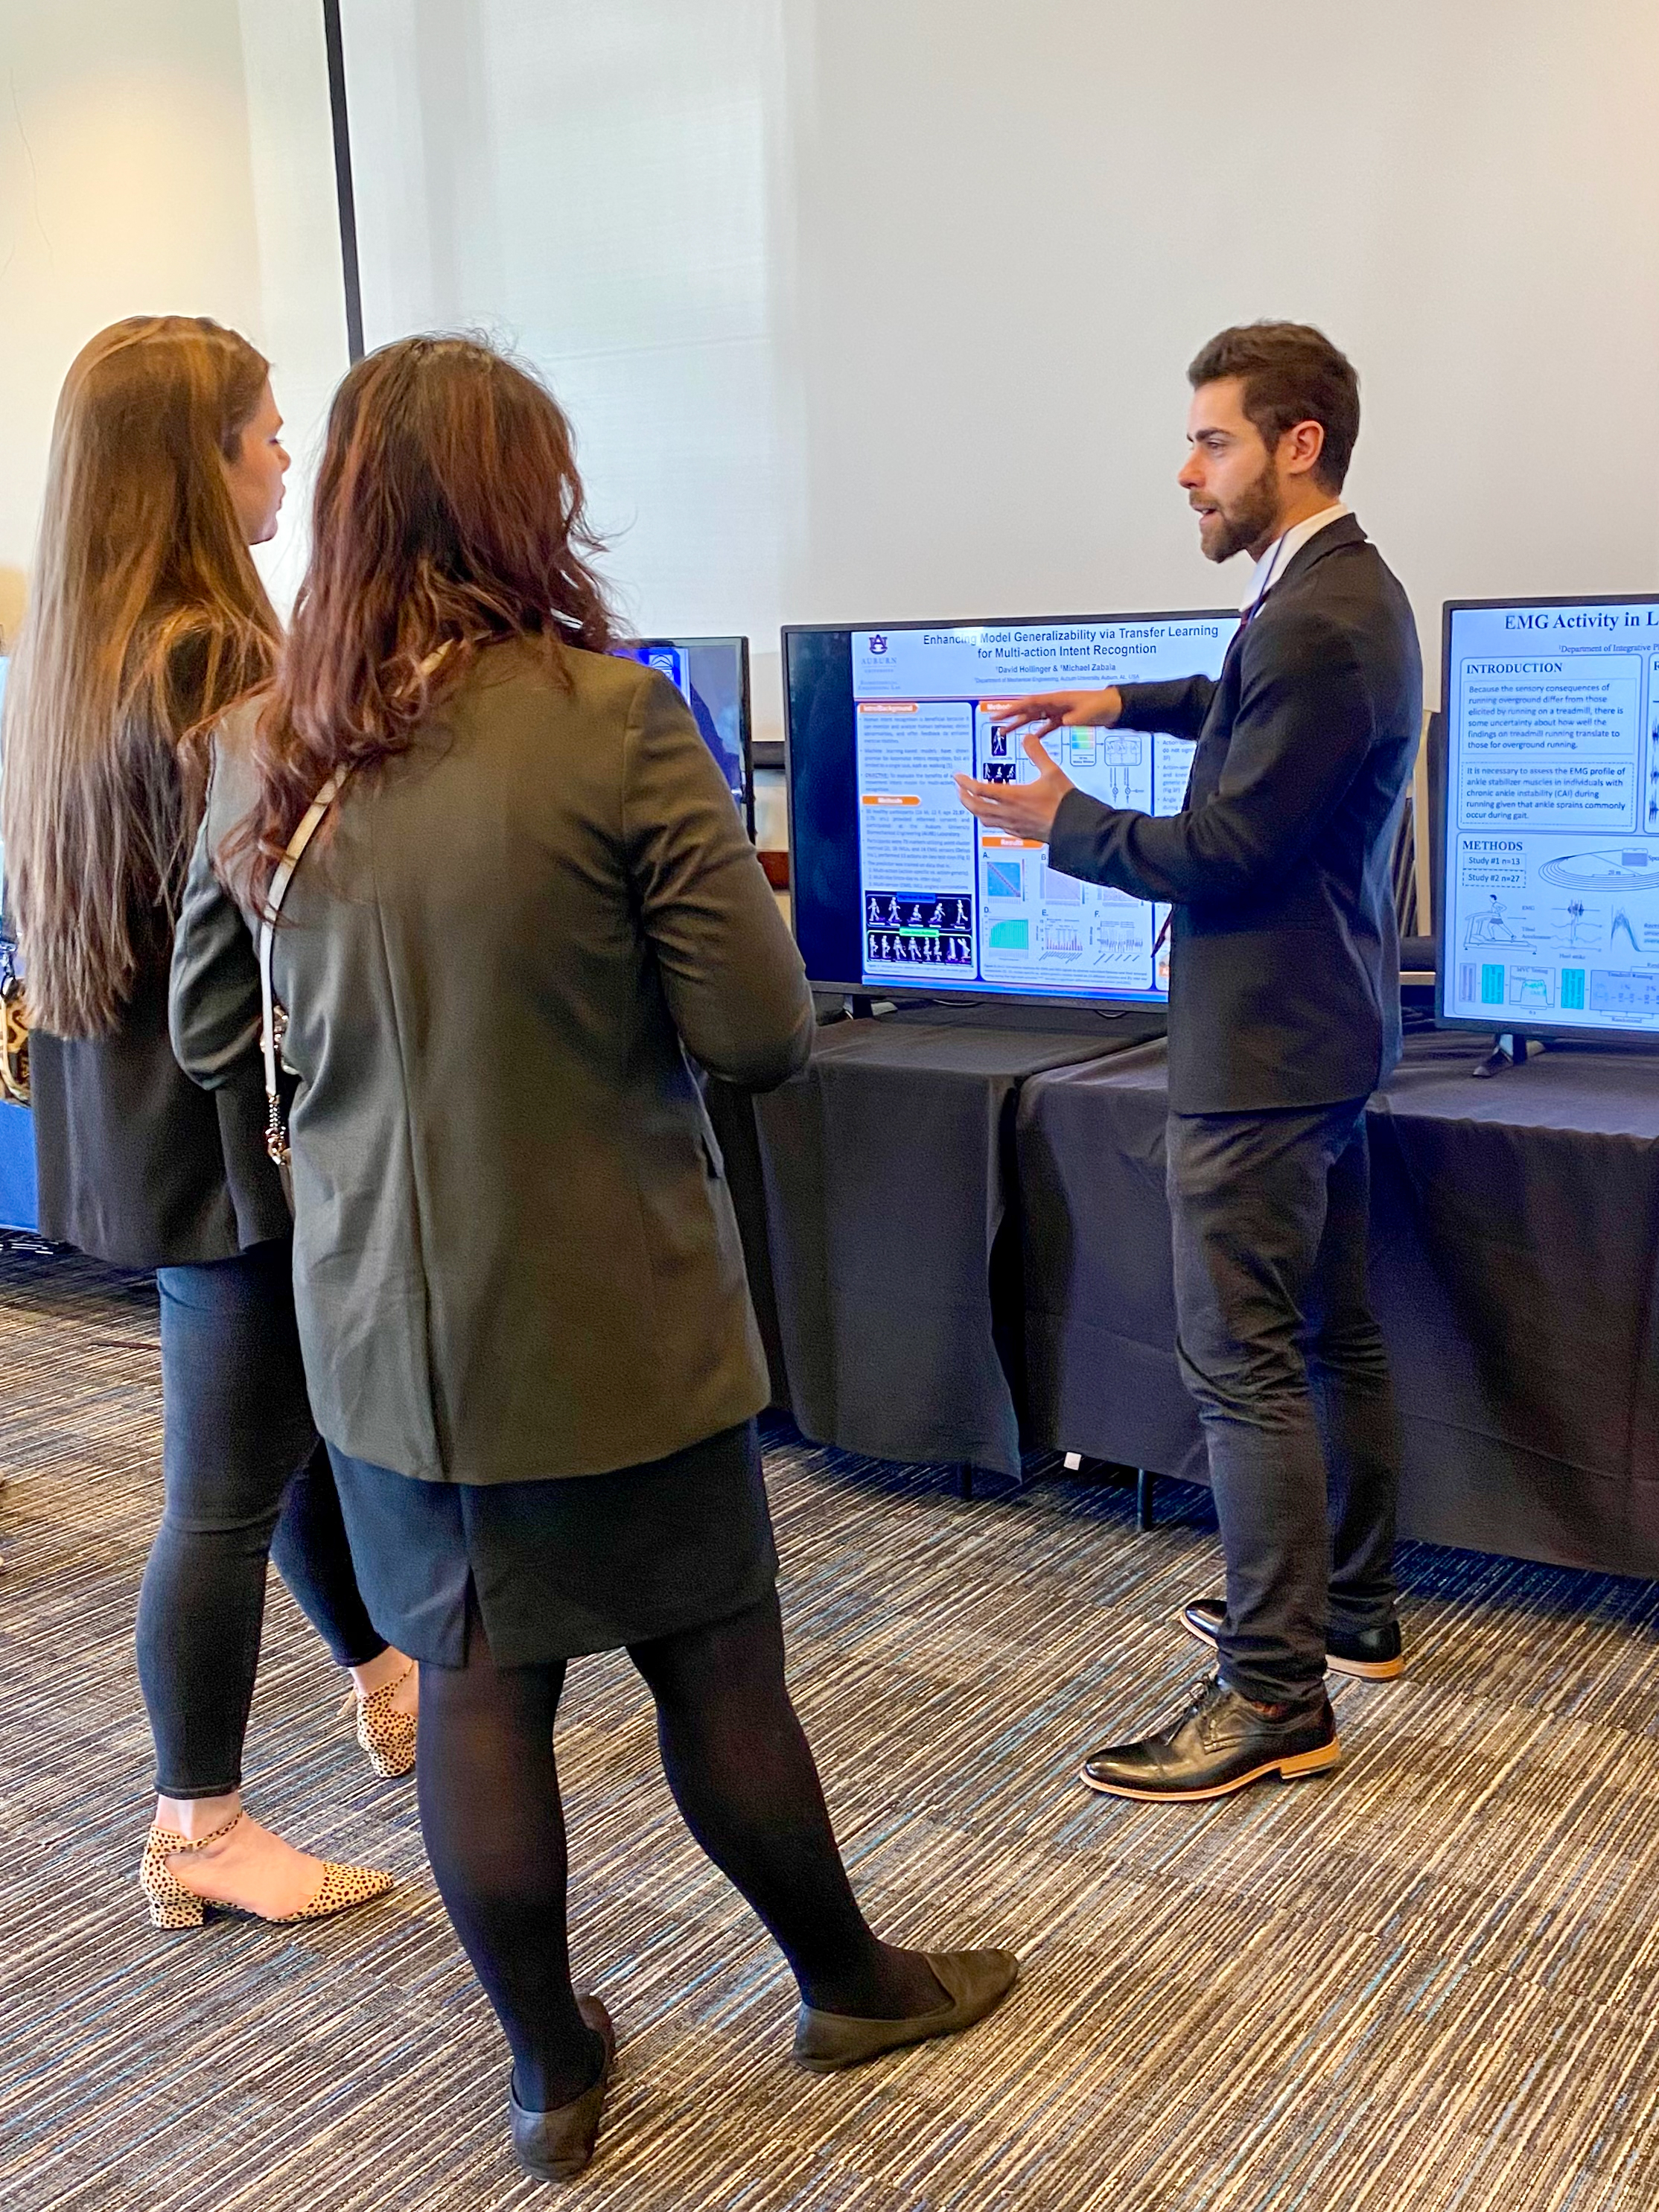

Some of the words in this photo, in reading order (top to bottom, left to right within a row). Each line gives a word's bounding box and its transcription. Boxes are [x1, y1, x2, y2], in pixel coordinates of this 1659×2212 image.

[1505, 615, 1548, 630] EMG
[1553, 613, 1619, 631] Activity
[1624, 612, 1640, 626] in
[924, 634, 976, 646] Enhancing
[981, 633, 1010, 643] Model
[1014, 630, 1096, 642] Generalizability
[1101, 629, 1115, 639] via
[1119, 627, 1165, 638] Transfer
[1169, 625, 1218, 637] Learning
[978, 648, 993, 658] for
[996, 646, 1056, 658] Multi-action
[1060, 646, 1090, 656] Intent
[1094, 643, 1156, 657] Recogntion
[1604, 644, 1611, 652] of
[1614, 644, 1650, 652] Integrative
[1019, 665, 1051, 674] Hollinger
[1467, 663, 1562, 674] INTRODUCTION
[1515, 686, 1544, 694] sensory
[1546, 685, 1599, 694] consequences
[1468, 697, 1497, 705] running
[1499, 697, 1541, 705] overground
[1544, 695, 1564, 704] differ
[1468, 707, 1495, 715] elicited
[1497, 707, 1506, 716] by
[1508, 708, 1536, 716] running
[1490, 718, 1532, 728] uncertainty
[1468, 730, 1496, 739] findings
[1545, 730, 1574, 739] running
[1503, 742, 1545, 750] overground
[1482, 768, 1518, 776] necessary
[1590, 768, 1615, 776] profile
[1488, 778, 1521, 786] stabilizer
[1564, 778, 1603, 786] individuals
[1518, 790, 1553, 799] instability
[1555, 790, 1573, 798] (CAI)
[1575, 790, 1599, 799] during
[1466, 801, 1494, 809] running
[1496, 801, 1515, 809] given
[1556, 802, 1583, 810] sprains
[1585, 801, 1625, 811] commonly
[1488, 812, 1512, 820] during
[1463, 841, 1523, 851] METHODS
[1469, 857, 1488, 866] Study
[1468, 874, 1488, 883] Study
[1490, 874, 1499, 882] #2
